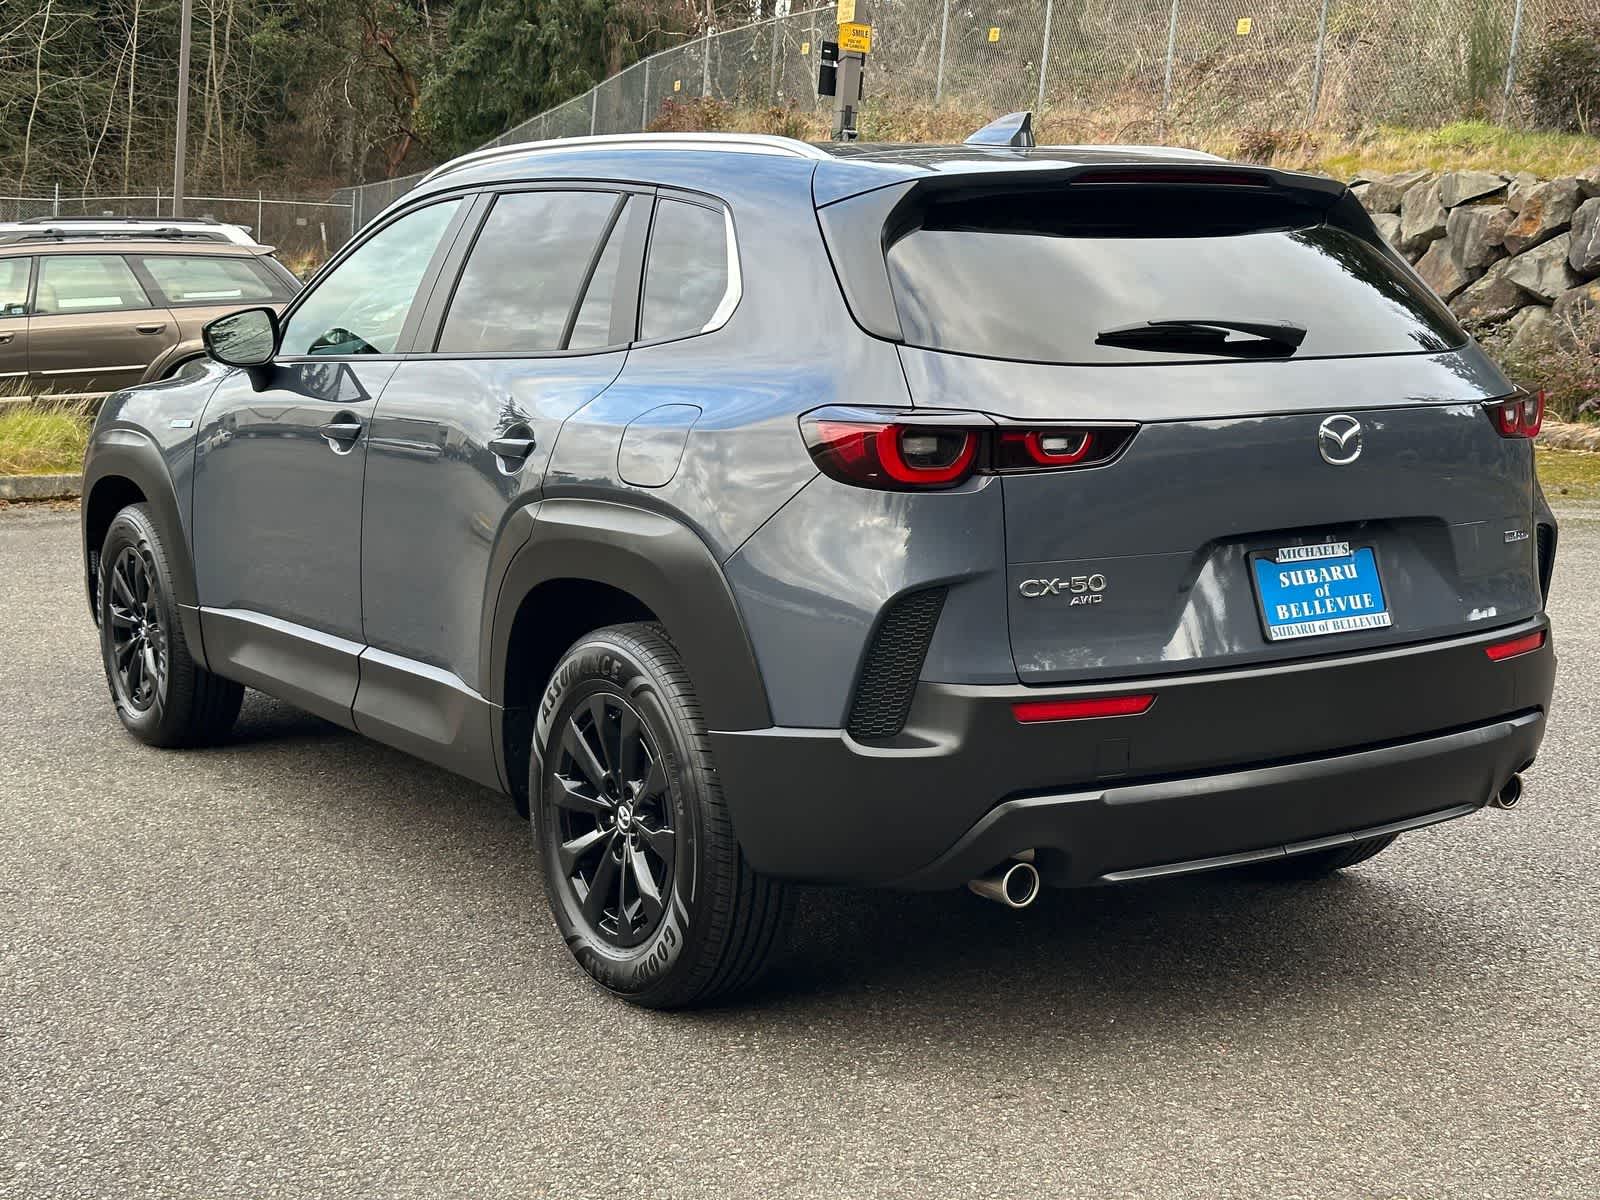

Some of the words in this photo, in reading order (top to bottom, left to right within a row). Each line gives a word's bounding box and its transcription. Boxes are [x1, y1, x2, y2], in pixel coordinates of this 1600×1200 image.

[852, 28, 869, 39] SMILE
[1280, 543, 1348, 560] MICHAEL'S
[1019, 573, 1106, 597] CX-50
[1279, 563, 1358, 588] SUBARU
[1069, 594, 1103, 606] AWD
[1315, 583, 1330, 598] of
[1276, 593, 1375, 620] BELLEVUE
[1272, 624, 1317, 638] SUBARU
[1318, 622, 1330, 633] of
[1333, 614, 1389, 631] BELLEVUE
[541, 654, 622, 725] ASSURANCE
